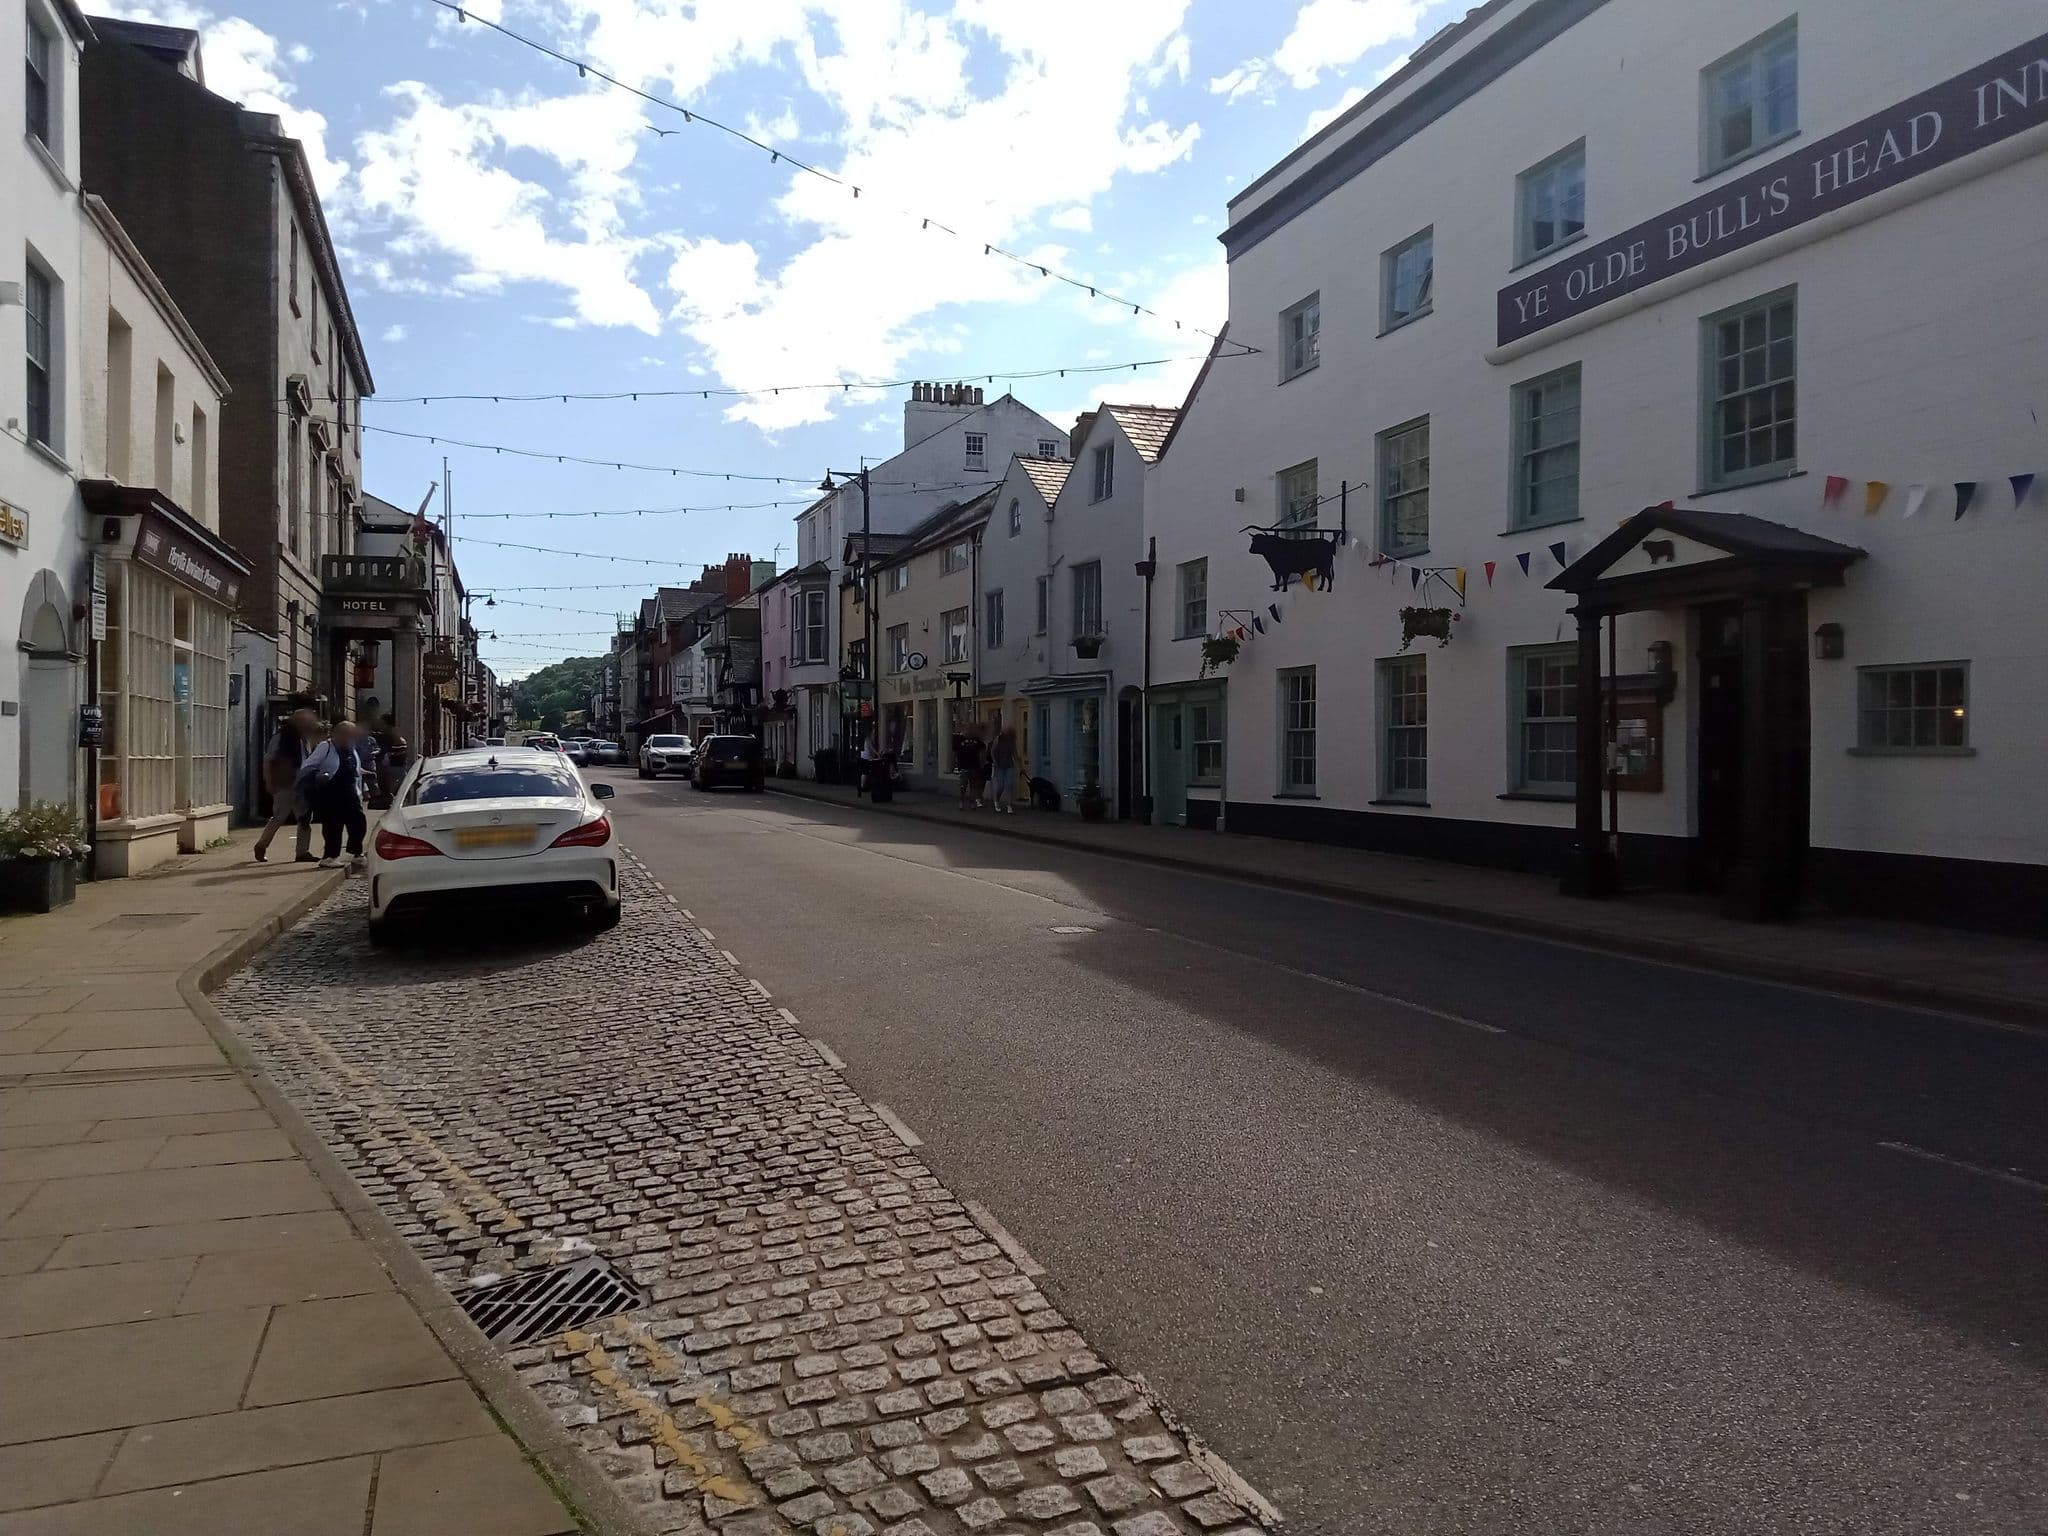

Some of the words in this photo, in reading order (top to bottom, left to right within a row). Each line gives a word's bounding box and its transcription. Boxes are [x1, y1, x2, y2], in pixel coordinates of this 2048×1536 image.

[1514, 285, 1549, 324] YE
[1565, 240, 1646, 302] OLDE
[1666, 176, 1791, 261] BULL'S
[1811, 111, 1943, 200] HEAD
[342, 600, 387, 611] HOTEL
